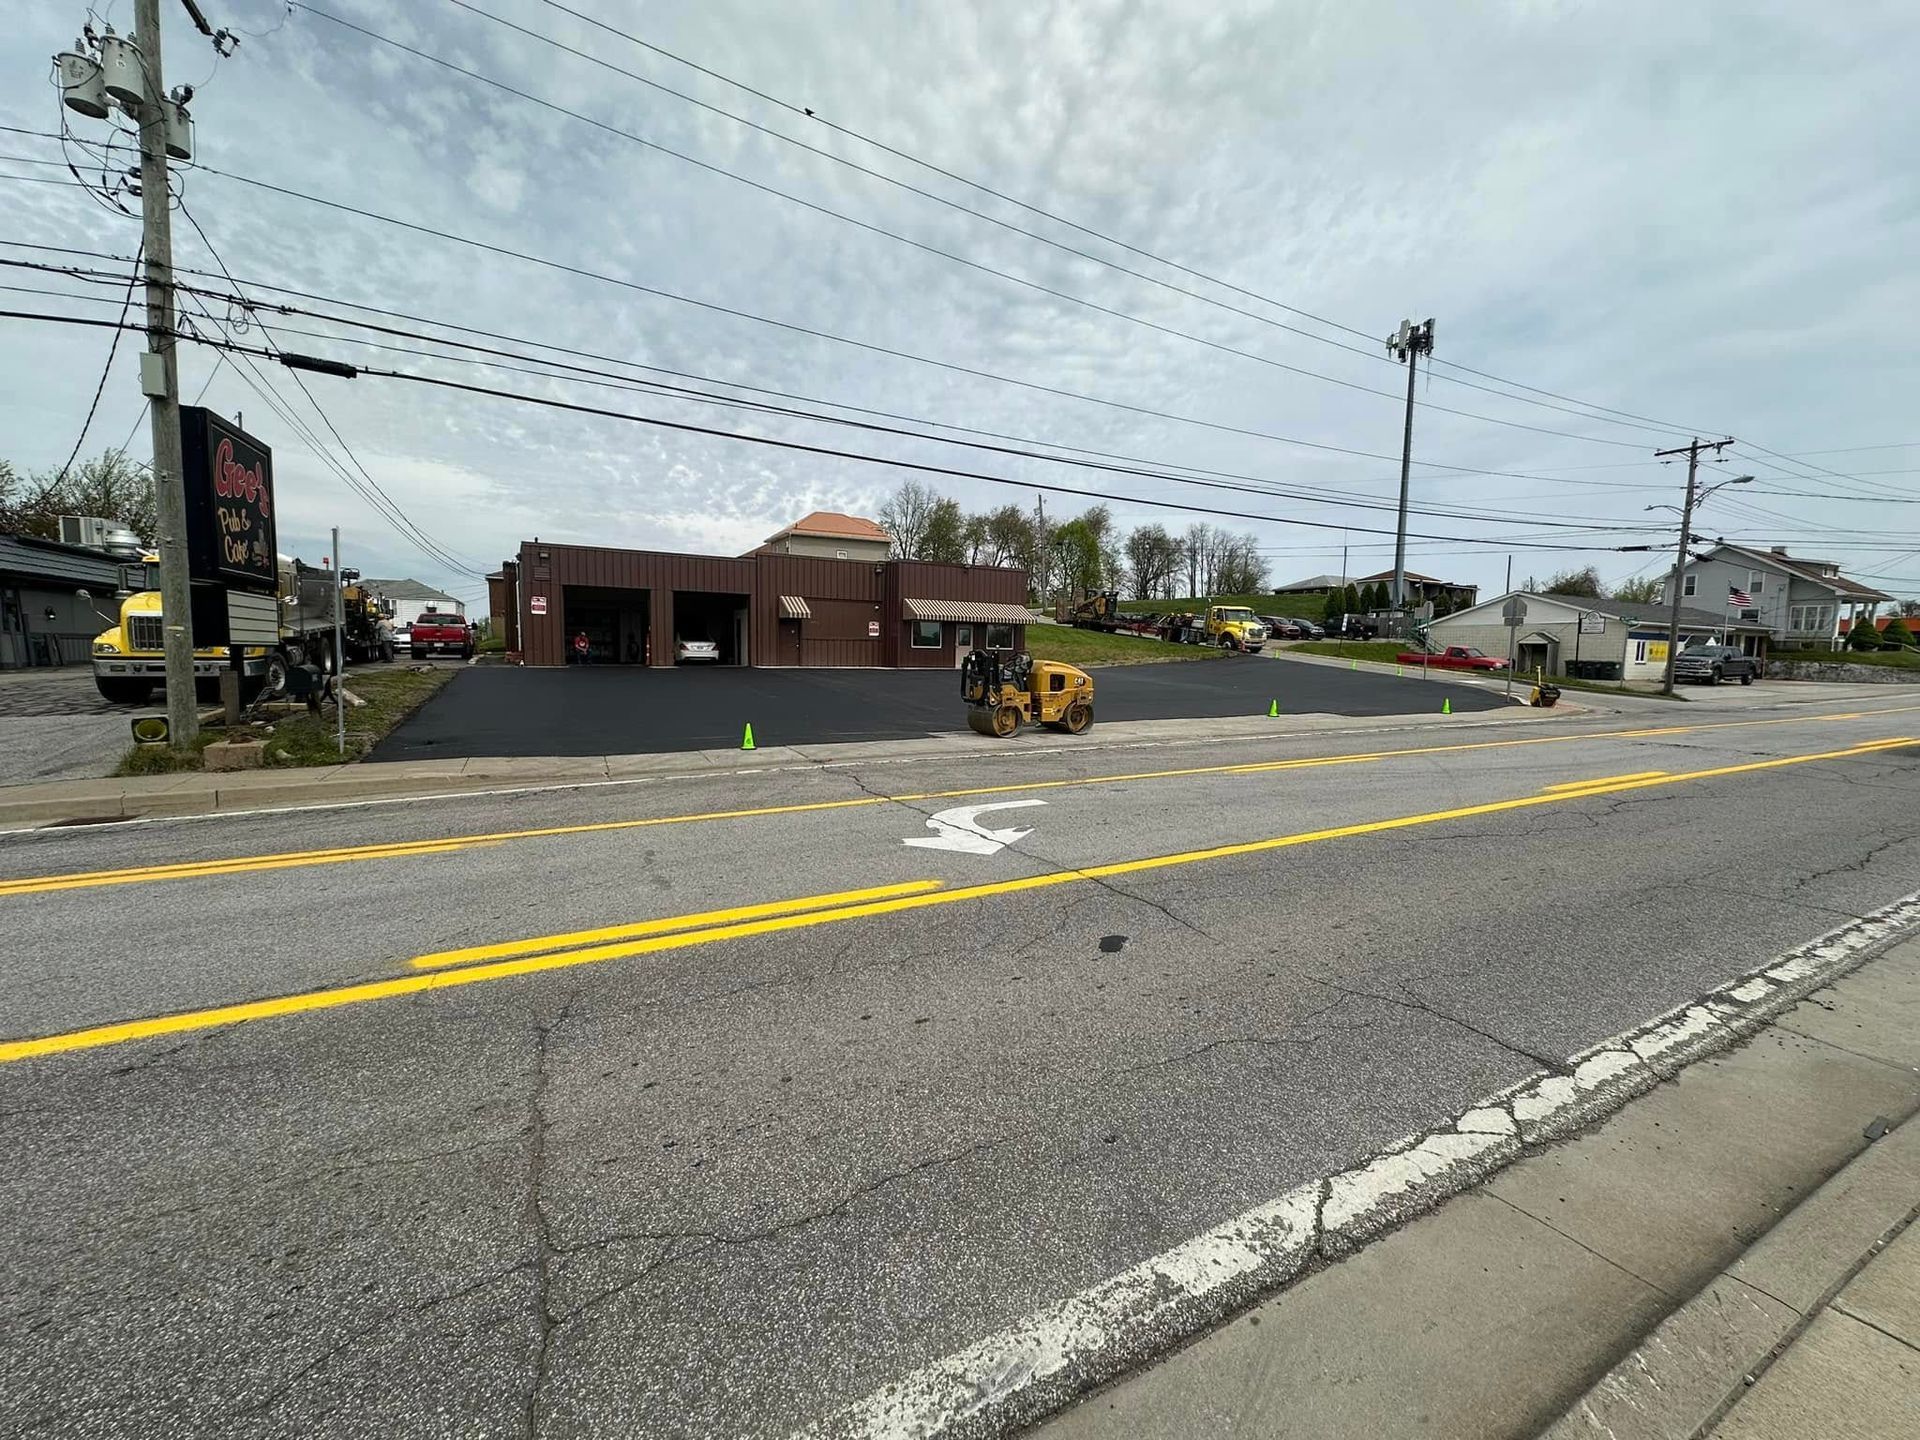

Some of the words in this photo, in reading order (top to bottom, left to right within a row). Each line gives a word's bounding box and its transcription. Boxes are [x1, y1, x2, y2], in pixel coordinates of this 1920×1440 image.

[215, 438, 269, 518] Gee's
[218, 506, 241, 534] Pub
[241, 508, 251, 531] &
